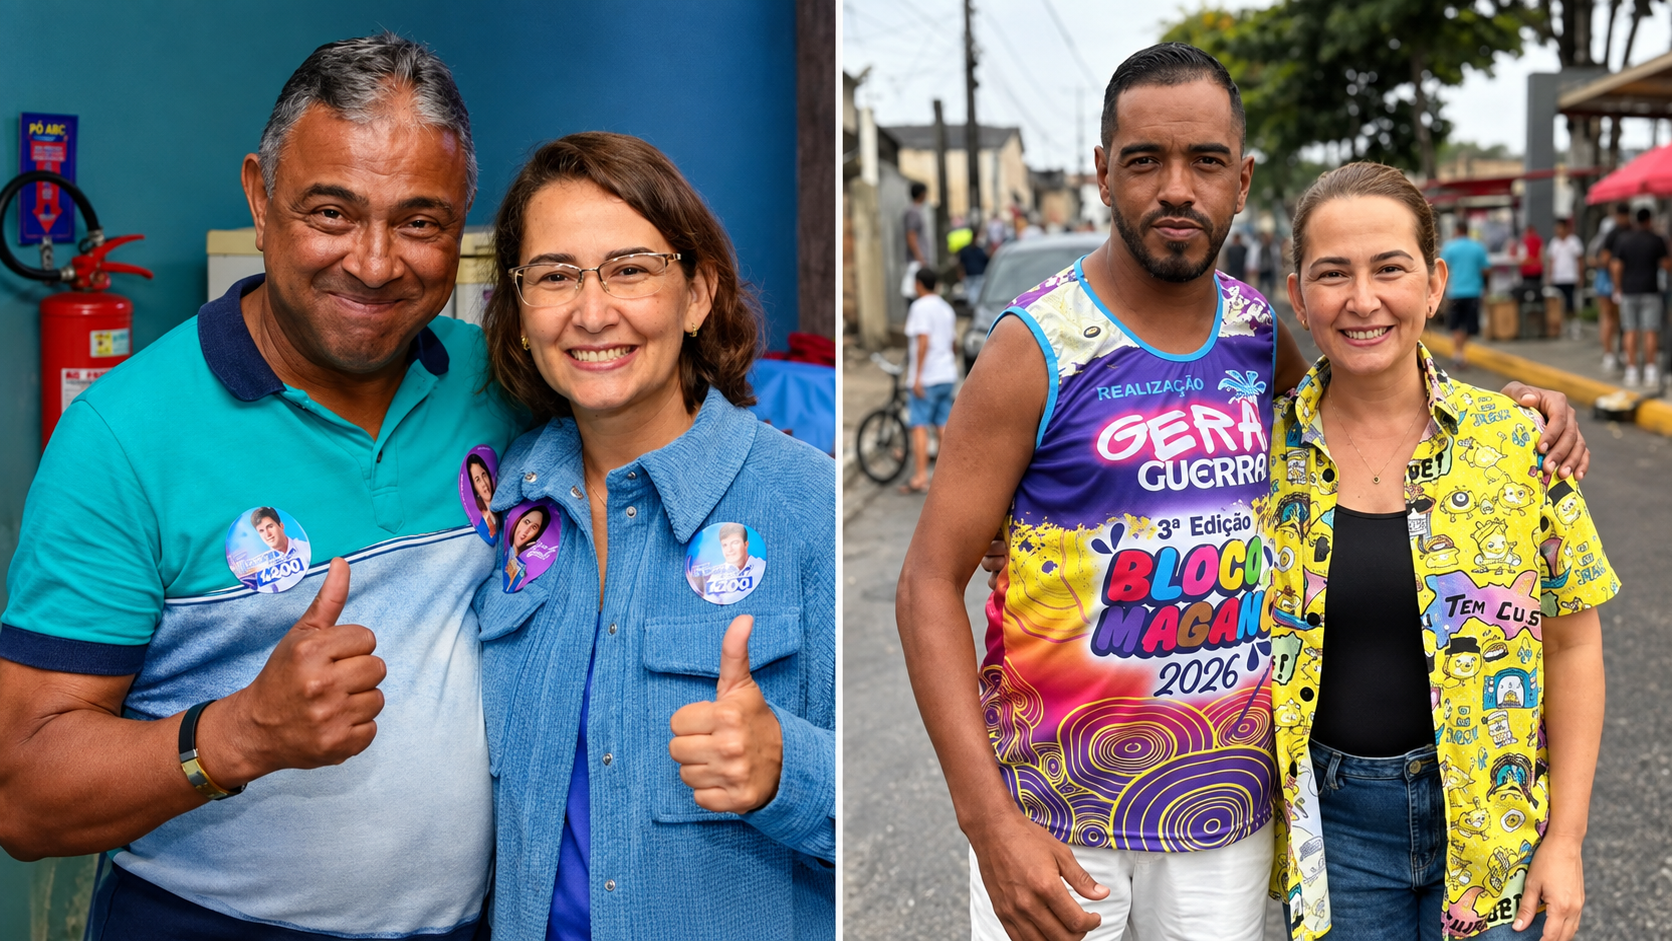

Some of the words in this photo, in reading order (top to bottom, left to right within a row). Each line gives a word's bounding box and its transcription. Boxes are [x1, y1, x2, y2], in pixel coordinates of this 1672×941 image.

[29, 120, 44, 135] PÓ
[45, 123, 66, 136] ABC
[1097, 375, 1204, 401] REALIZAÇÃO
[1137, 452, 1267, 492] GUERRA
[1189, 512, 1251, 537] Edição
[1104, 536, 1263, 604] BLOCO
[1445, 594, 1485, 617] TEM
[1153, 653, 1240, 697] 2026
